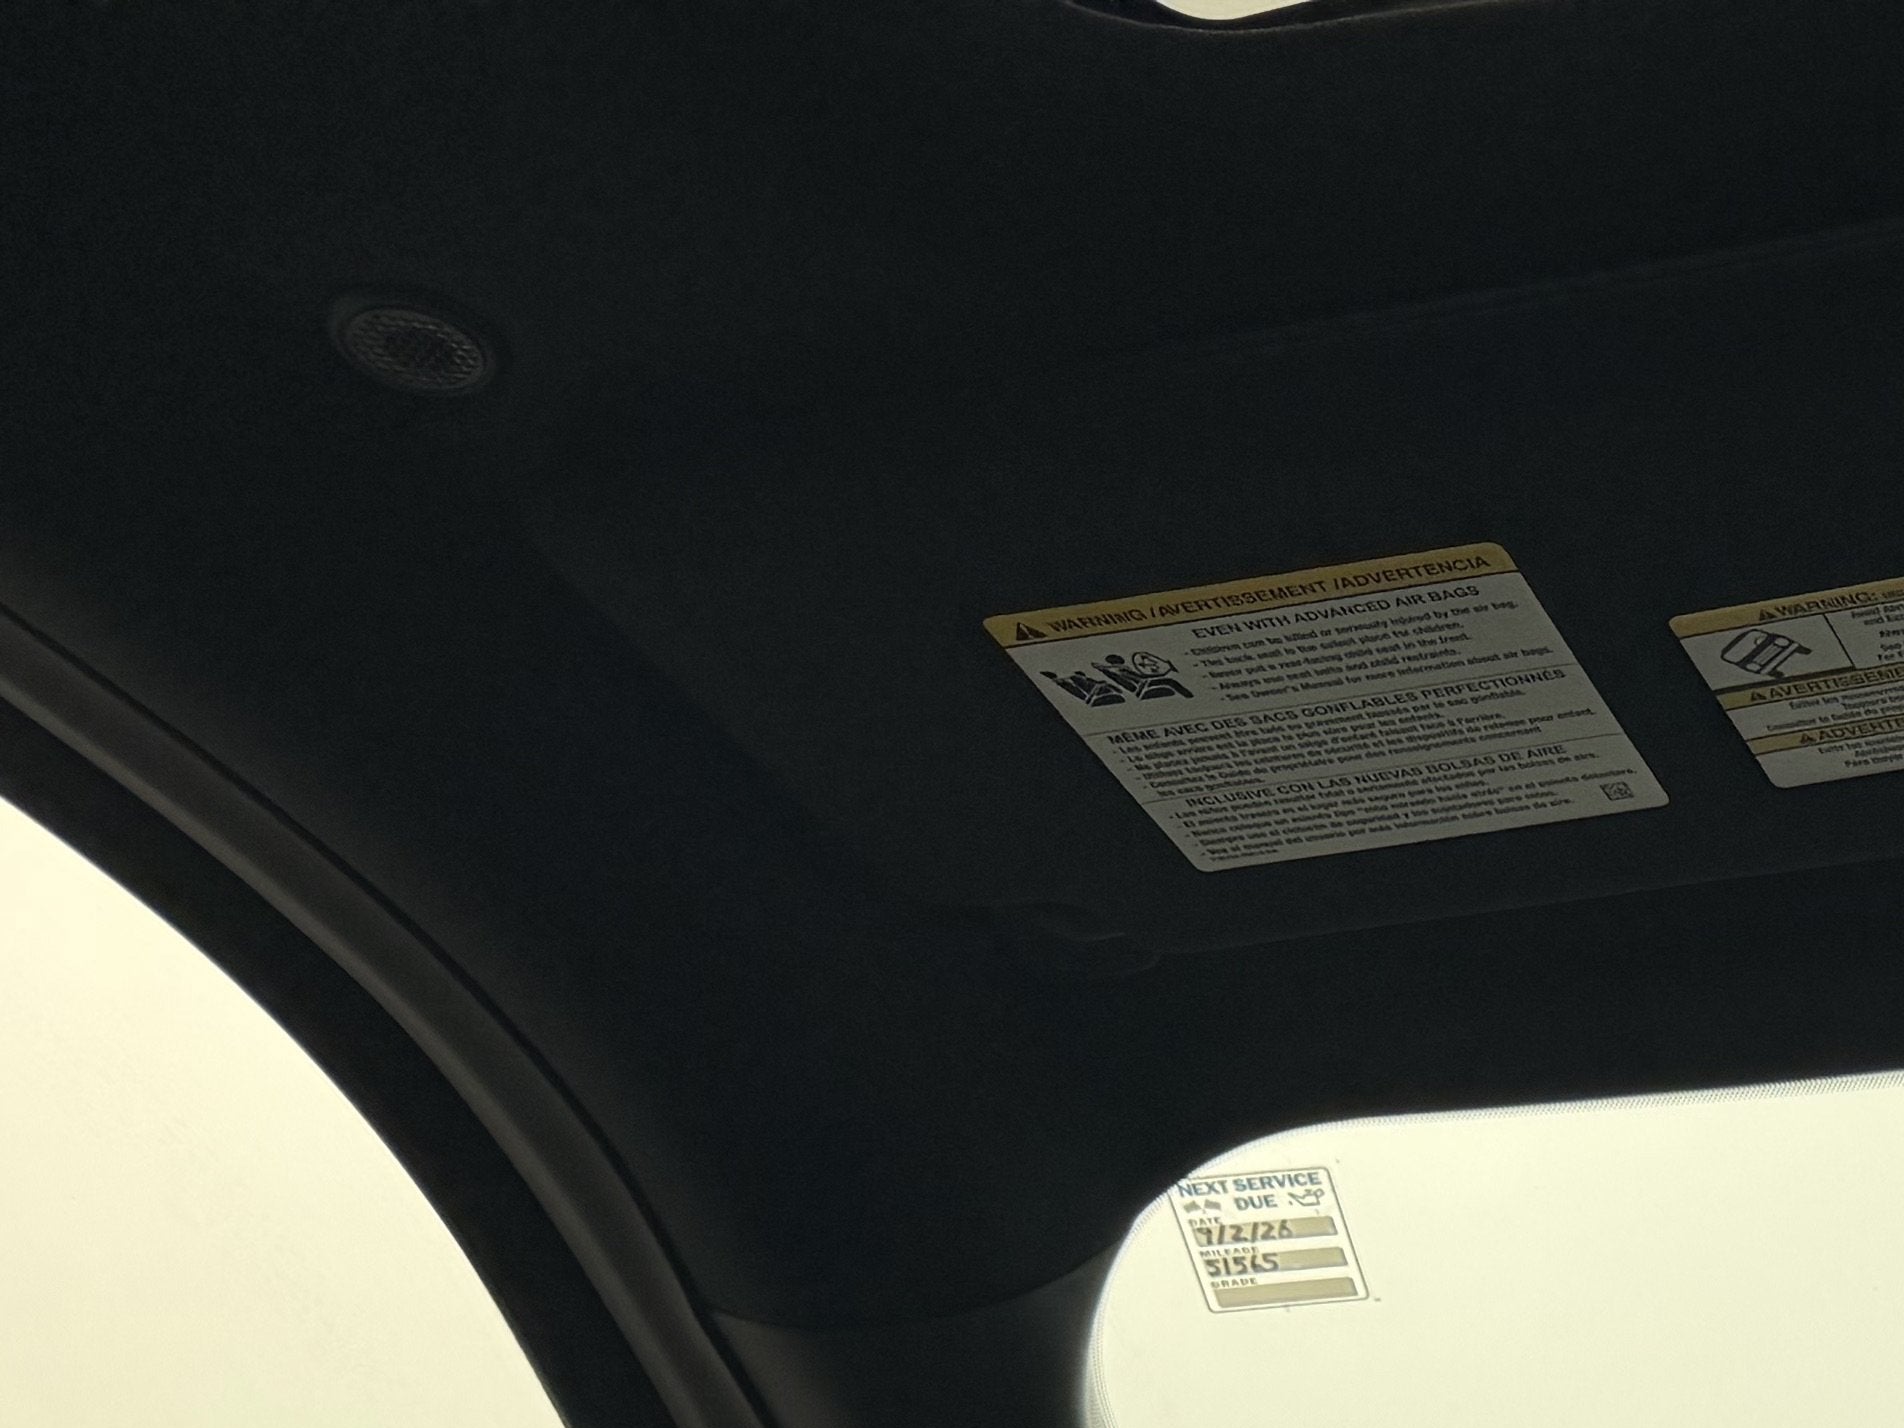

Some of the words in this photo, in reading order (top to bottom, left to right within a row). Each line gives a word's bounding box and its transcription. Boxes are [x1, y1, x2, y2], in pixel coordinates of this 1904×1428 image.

[1190, 622, 1243, 639] EVEN
[1242, 614, 1292, 631] WITH
[1288, 598, 1392, 624] ADVANCED
[1391, 593, 1426, 607] AIR
[1425, 584, 1481, 602] BAGS
[1773, 590, 1879, 617] WARNING:
[1045, 607, 1147, 633] WARNING
[1160, 722, 1209, 737] AVEC
[1209, 716, 1248, 731] DES
[1247, 708, 1300, 725] SACS
[1298, 690, 1420, 718] GONFLABLES
[1183, 786, 1276, 808] INCLUSIVE
[1274, 781, 1316, 795] CON
[1315, 776, 1353, 790] LAS
[1352, 765, 1424, 784] NUEVAS
[1497, 750, 1525, 762] DE
[1523, 744, 1567, 758] AIRE
[1177, 1179, 1231, 1198] NEXT
[1233, 1172, 1323, 1192] SERVICE
[1234, 1194, 1278, 1211] DUE
[1188, 1217, 1222, 1227] DATE
[1198, 1246, 1260, 1258] MILEAGE
[1210, 1277, 1258, 1289] GRADE
